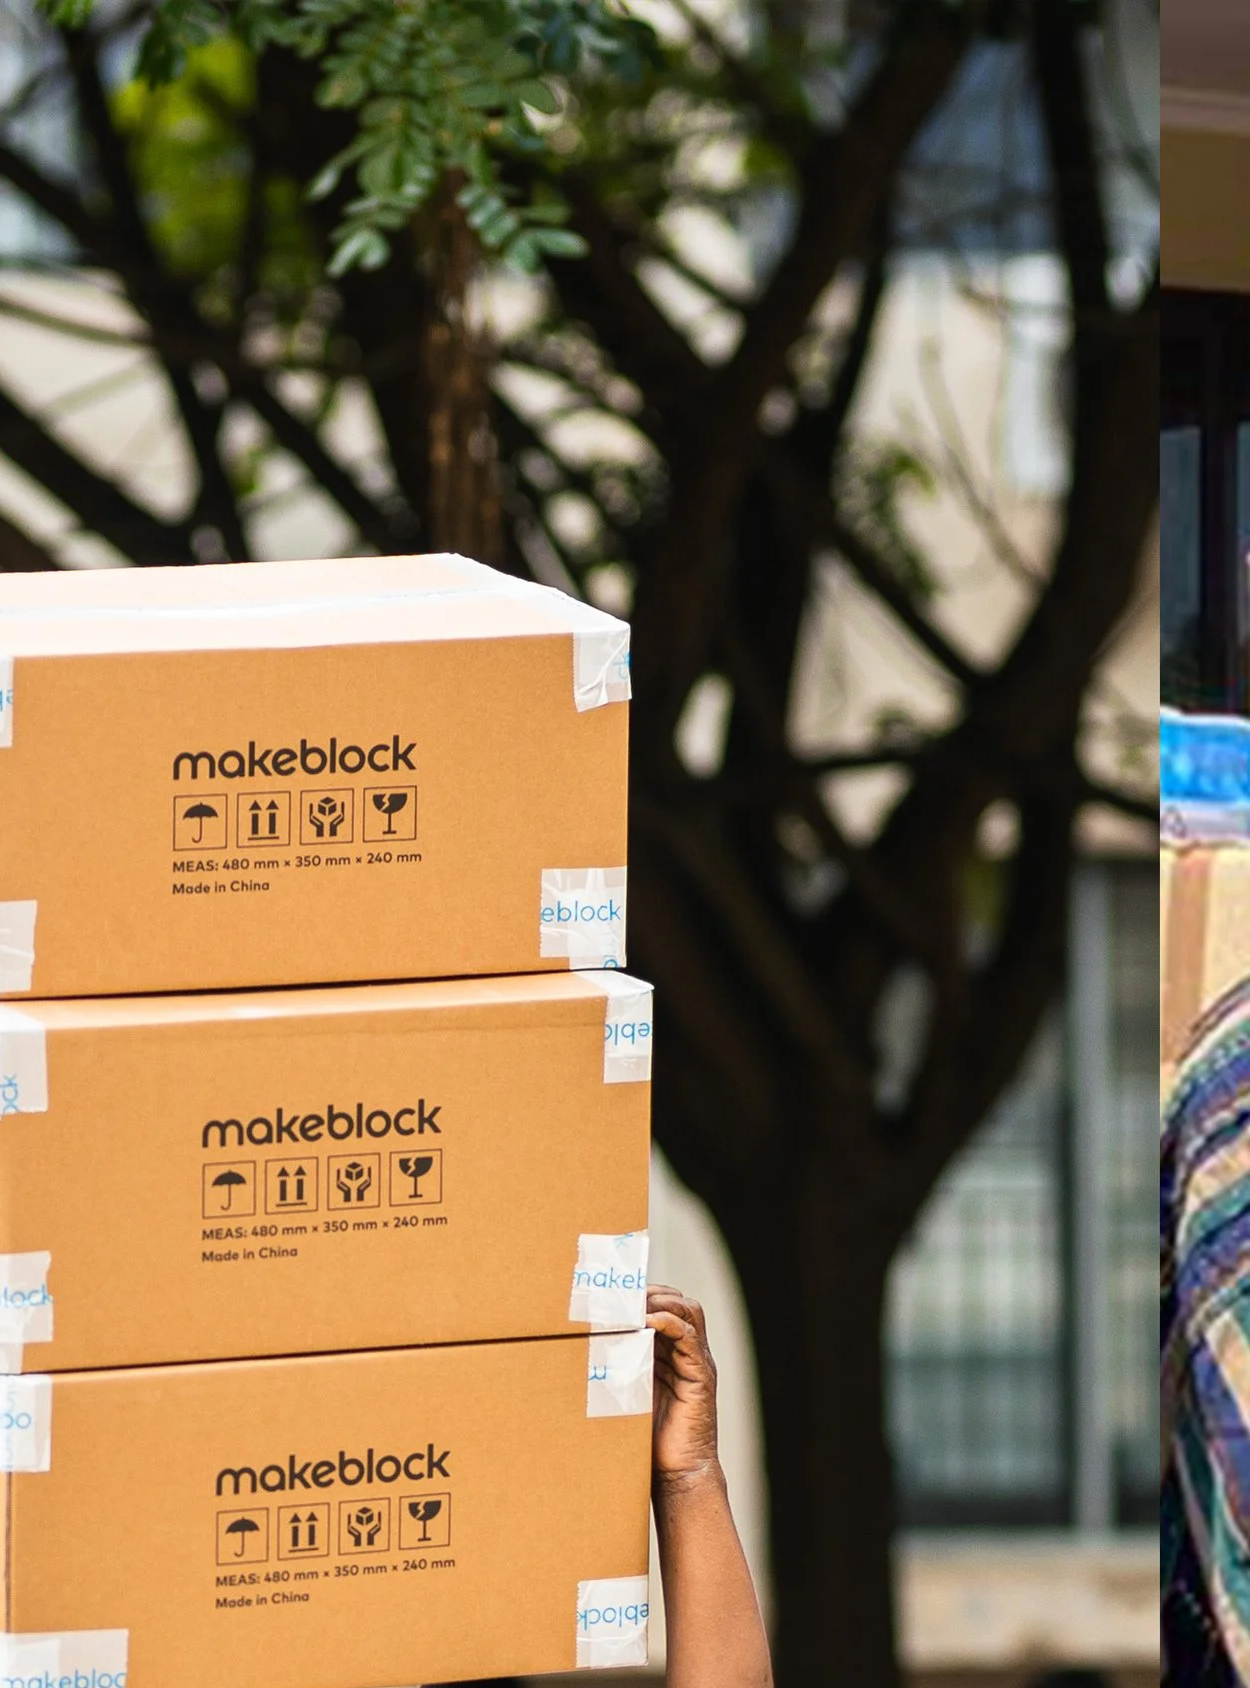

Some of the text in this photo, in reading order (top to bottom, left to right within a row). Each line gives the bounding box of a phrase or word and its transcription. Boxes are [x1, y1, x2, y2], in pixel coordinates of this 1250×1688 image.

[172, 734, 418, 781] makeblock
[172, 859, 219, 873] MEAS:
[222, 858, 250, 871] 480
[253, 860, 280, 869] mm
[295, 855, 322, 868] 350
[325, 856, 351, 866] mm
[367, 851, 393, 865] 240
[396, 854, 422, 863] mm
[172, 880, 270, 895] Made in China
[201, 1098, 443, 1149] makeblock
[201, 1227, 248, 1241] MEAS:
[251, 1225, 279, 1237] 480
[281, 1226, 308, 1235] mm
[323, 1220, 349, 1233] 350
[352, 1221, 378, 1231] mm
[393, 1216, 419, 1228] 240
[422, 1216, 448, 1225] mm
[201, 1246, 298, 1262] Made in China
[215, 1443, 451, 1497] makeblock
[215, 1573, 261, 1587] MEAS:
[263, 1570, 290, 1583] 480
[293, 1571, 319, 1581] mm
[335, 1564, 359, 1577] 350
[362, 1566, 387, 1575] mm
[403, 1559, 428, 1571] 240
[431, 1559, 456, 1568] mm
[215, 1592, 310, 1609] Made in China
